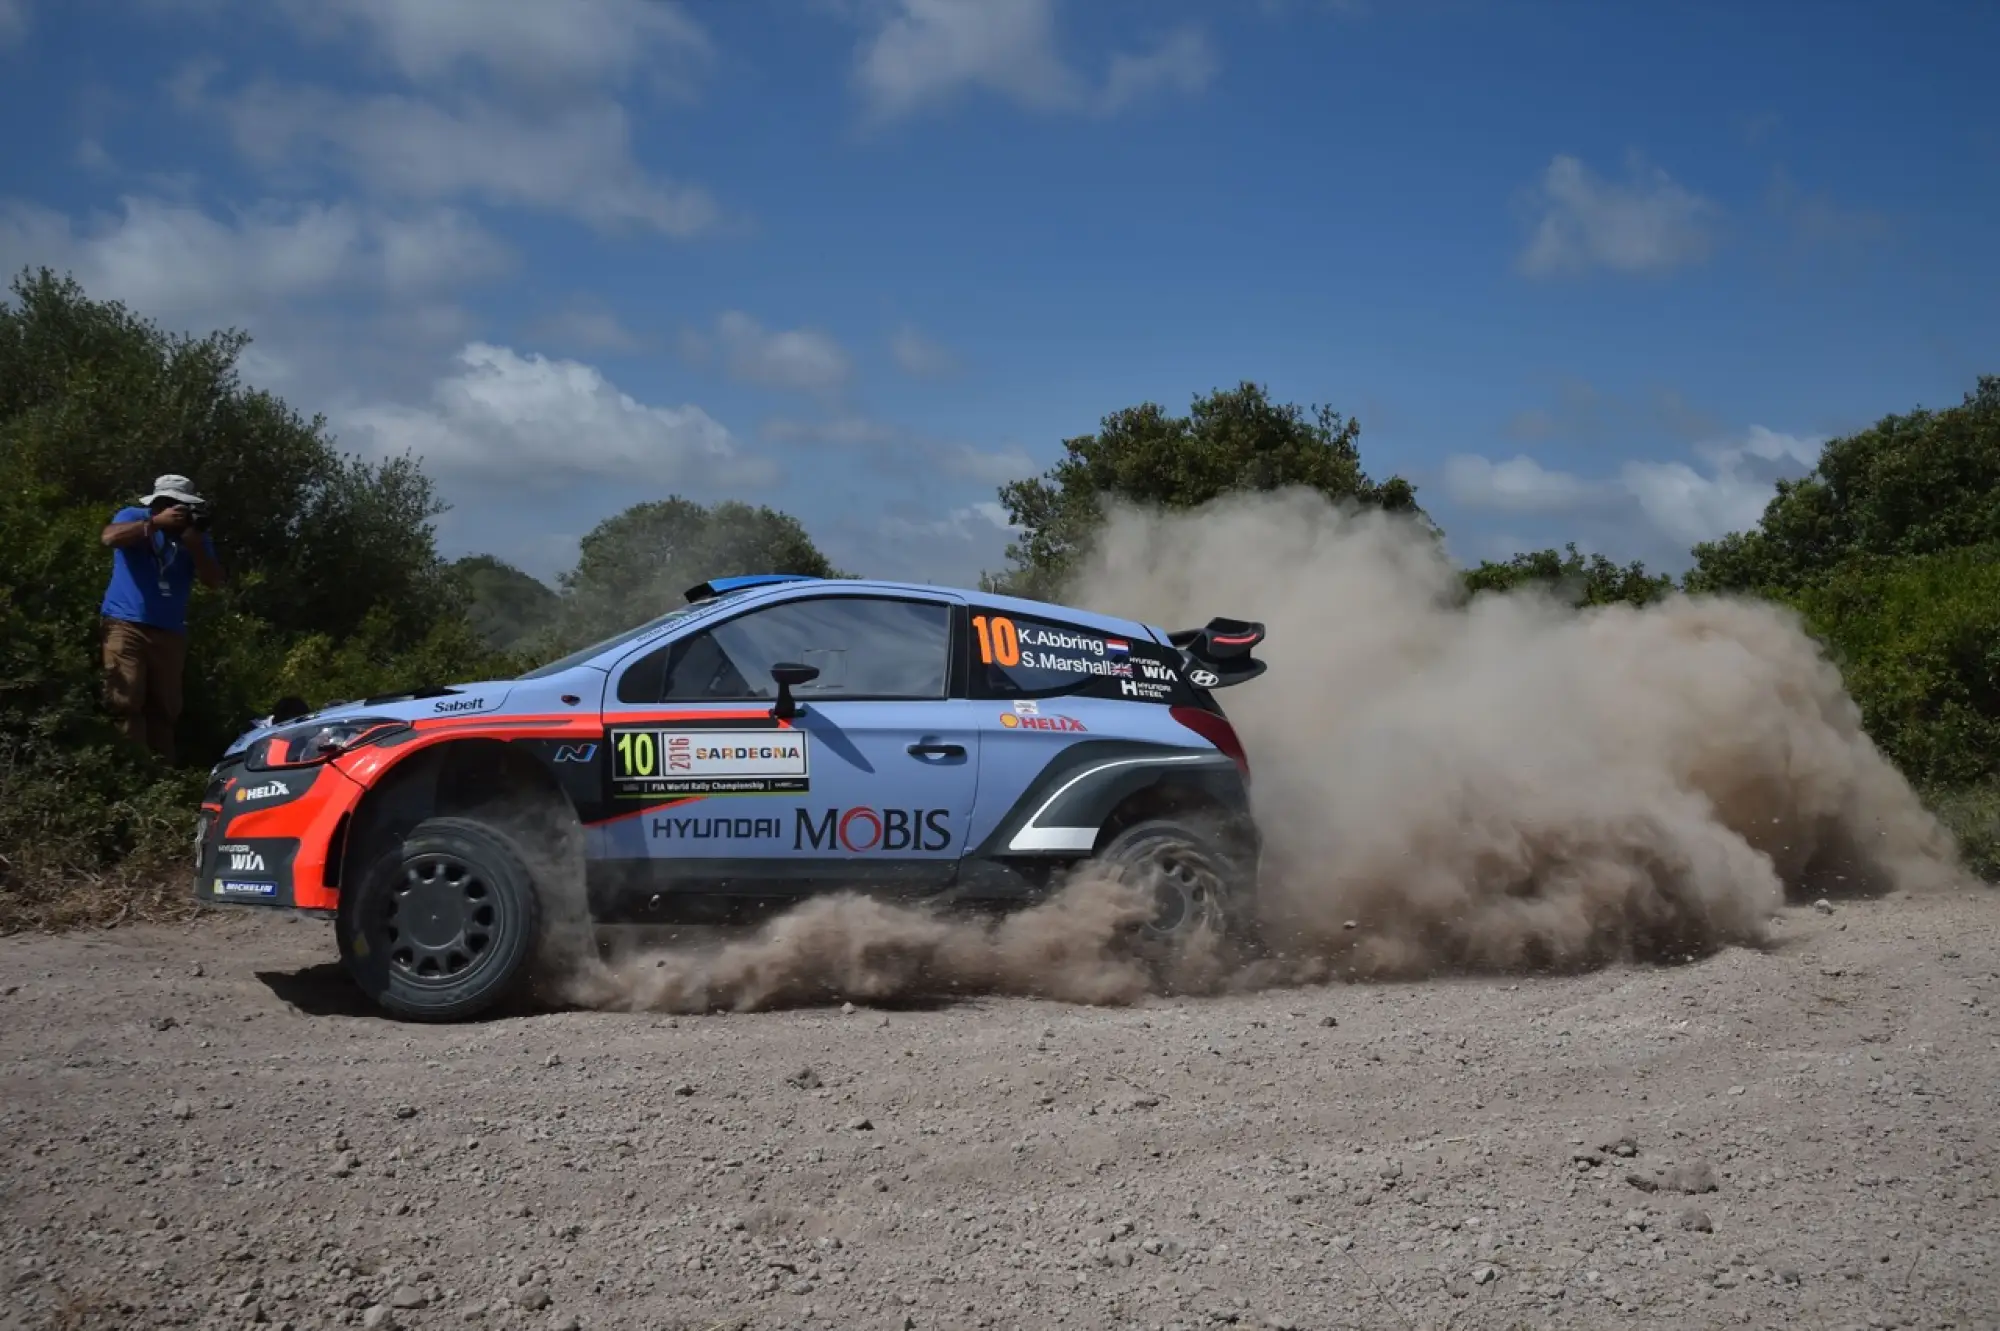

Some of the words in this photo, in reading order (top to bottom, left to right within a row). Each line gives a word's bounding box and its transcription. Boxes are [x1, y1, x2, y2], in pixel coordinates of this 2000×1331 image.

[972, 615, 1019, 667] 10
[1018, 628, 1104, 655] K.Abbring
[1022, 651, 1111, 675] S.Marshall
[1138, 690, 1164, 699] STEEL
[1020, 714, 1088, 731] HELIX
[617, 733, 654, 776] 10
[669, 738, 691, 770] 2016
[696, 747, 800, 760] SARDEGNA
[247, 780, 290, 800] HELIX
[652, 783, 666, 791] FIA
[691, 782, 710, 791] Rally
[712, 781, 765, 791] Championship
[652, 818, 781, 839] HYUNDAI
[793, 806, 951, 852] MOBIS
